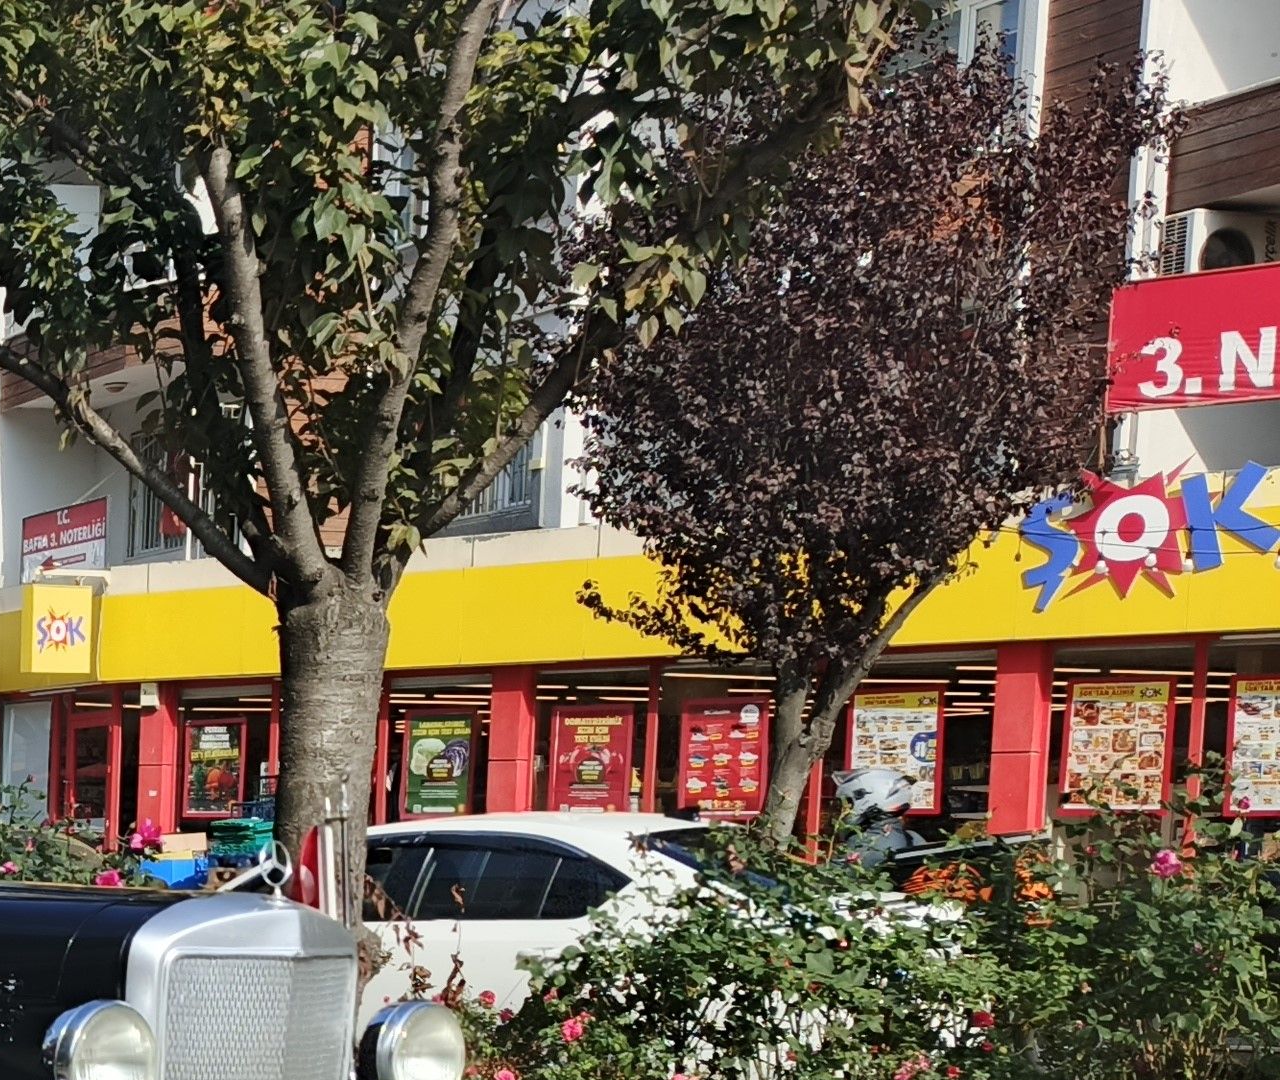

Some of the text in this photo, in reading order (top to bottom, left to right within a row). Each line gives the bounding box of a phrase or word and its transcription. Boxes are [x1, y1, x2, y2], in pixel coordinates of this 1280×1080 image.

[1137, 336, 1203, 399] 3.
[50, 531, 58, 548] 3.
[60, 516, 106, 546] NOTERLİĞİ
[1020, 459, 1280, 614] ŞOK
[36, 615, 86, 654] ŞOK
